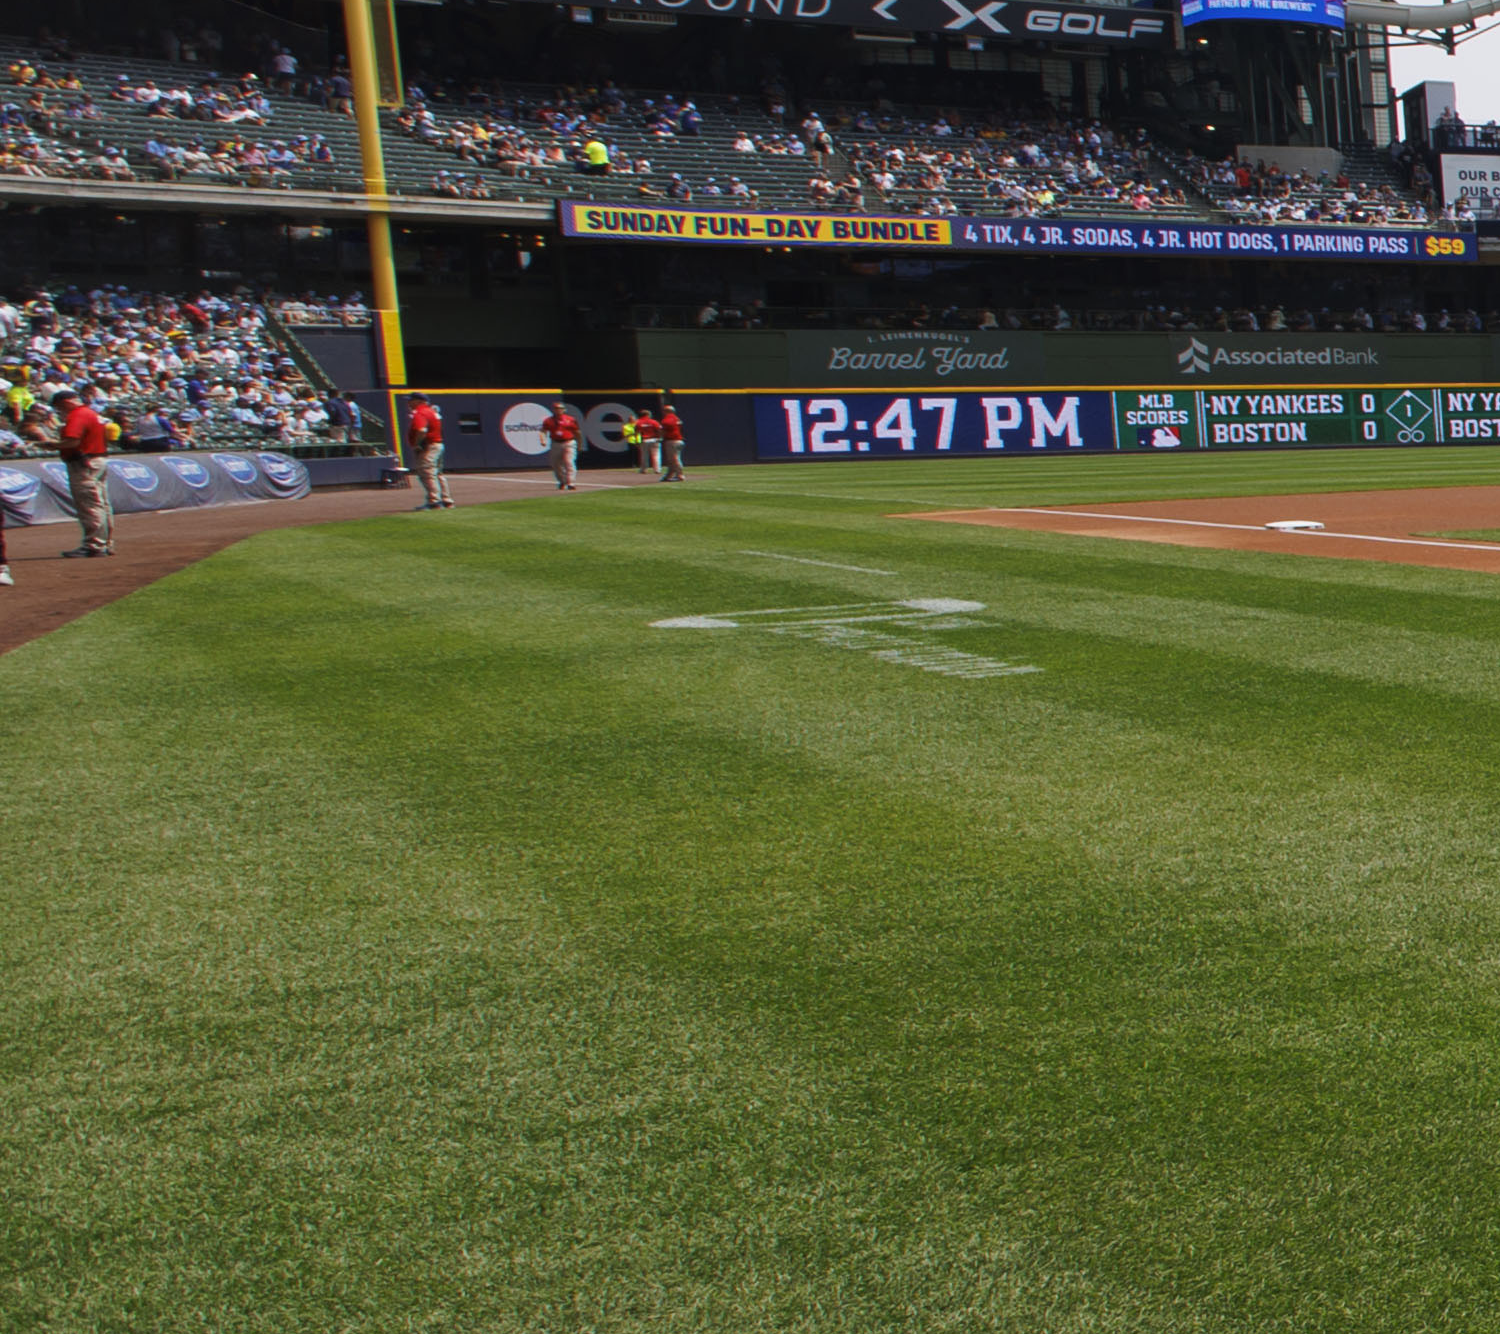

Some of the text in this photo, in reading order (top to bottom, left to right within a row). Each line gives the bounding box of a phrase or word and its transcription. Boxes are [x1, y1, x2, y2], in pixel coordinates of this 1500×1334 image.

[1025, 9, 1165, 39] GOLF
[1458, 170, 1488, 182] OUR
[1460, 186, 1489, 198] OUR
[586, 209, 940, 243] SUNDAY FUN-DAY BUNDLE
[963, 224, 1466, 256] 4 TIX, 4 JR. SODAS, 4 JR. HOT DOGS, 1 PARKING PASS $59
[828, 346, 1009, 376] Barrel Yard
[1138, 393, 1175, 409] MLB
[1211, 393, 1376, 416] NY YANKEES 0
[780, 395, 1084, 453] 12:47 PM
[1126, 410, 1190, 426] SCORES
[1213, 421, 1378, 444] BOSTON 0
